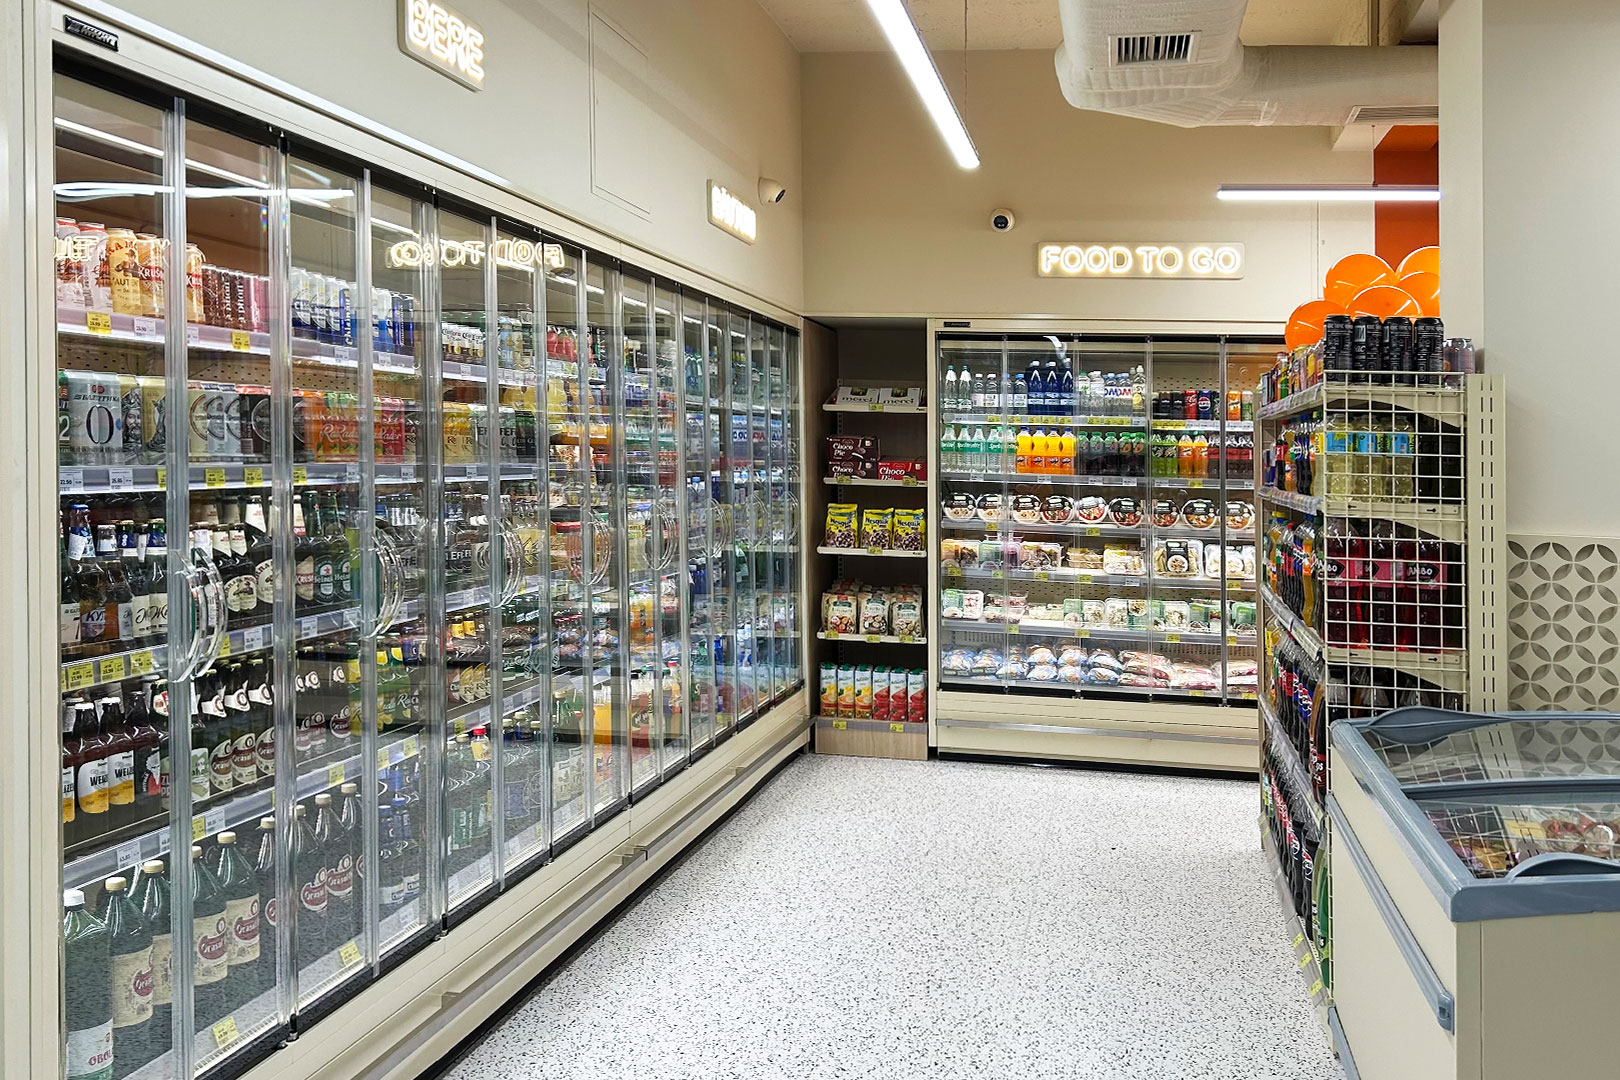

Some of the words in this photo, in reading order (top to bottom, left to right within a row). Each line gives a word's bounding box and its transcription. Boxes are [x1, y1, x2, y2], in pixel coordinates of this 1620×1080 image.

[408, 0, 484, 80] BERE
[1041, 246, 1133, 273] FOOD
[1135, 246, 1183, 273] TO
[1189, 246, 1240, 273] GO
[832, 442, 854, 450] Choco
[834, 449, 846, 457] Pie
[832, 465, 854, 473] Choco
[879, 467, 906, 475] Choco
